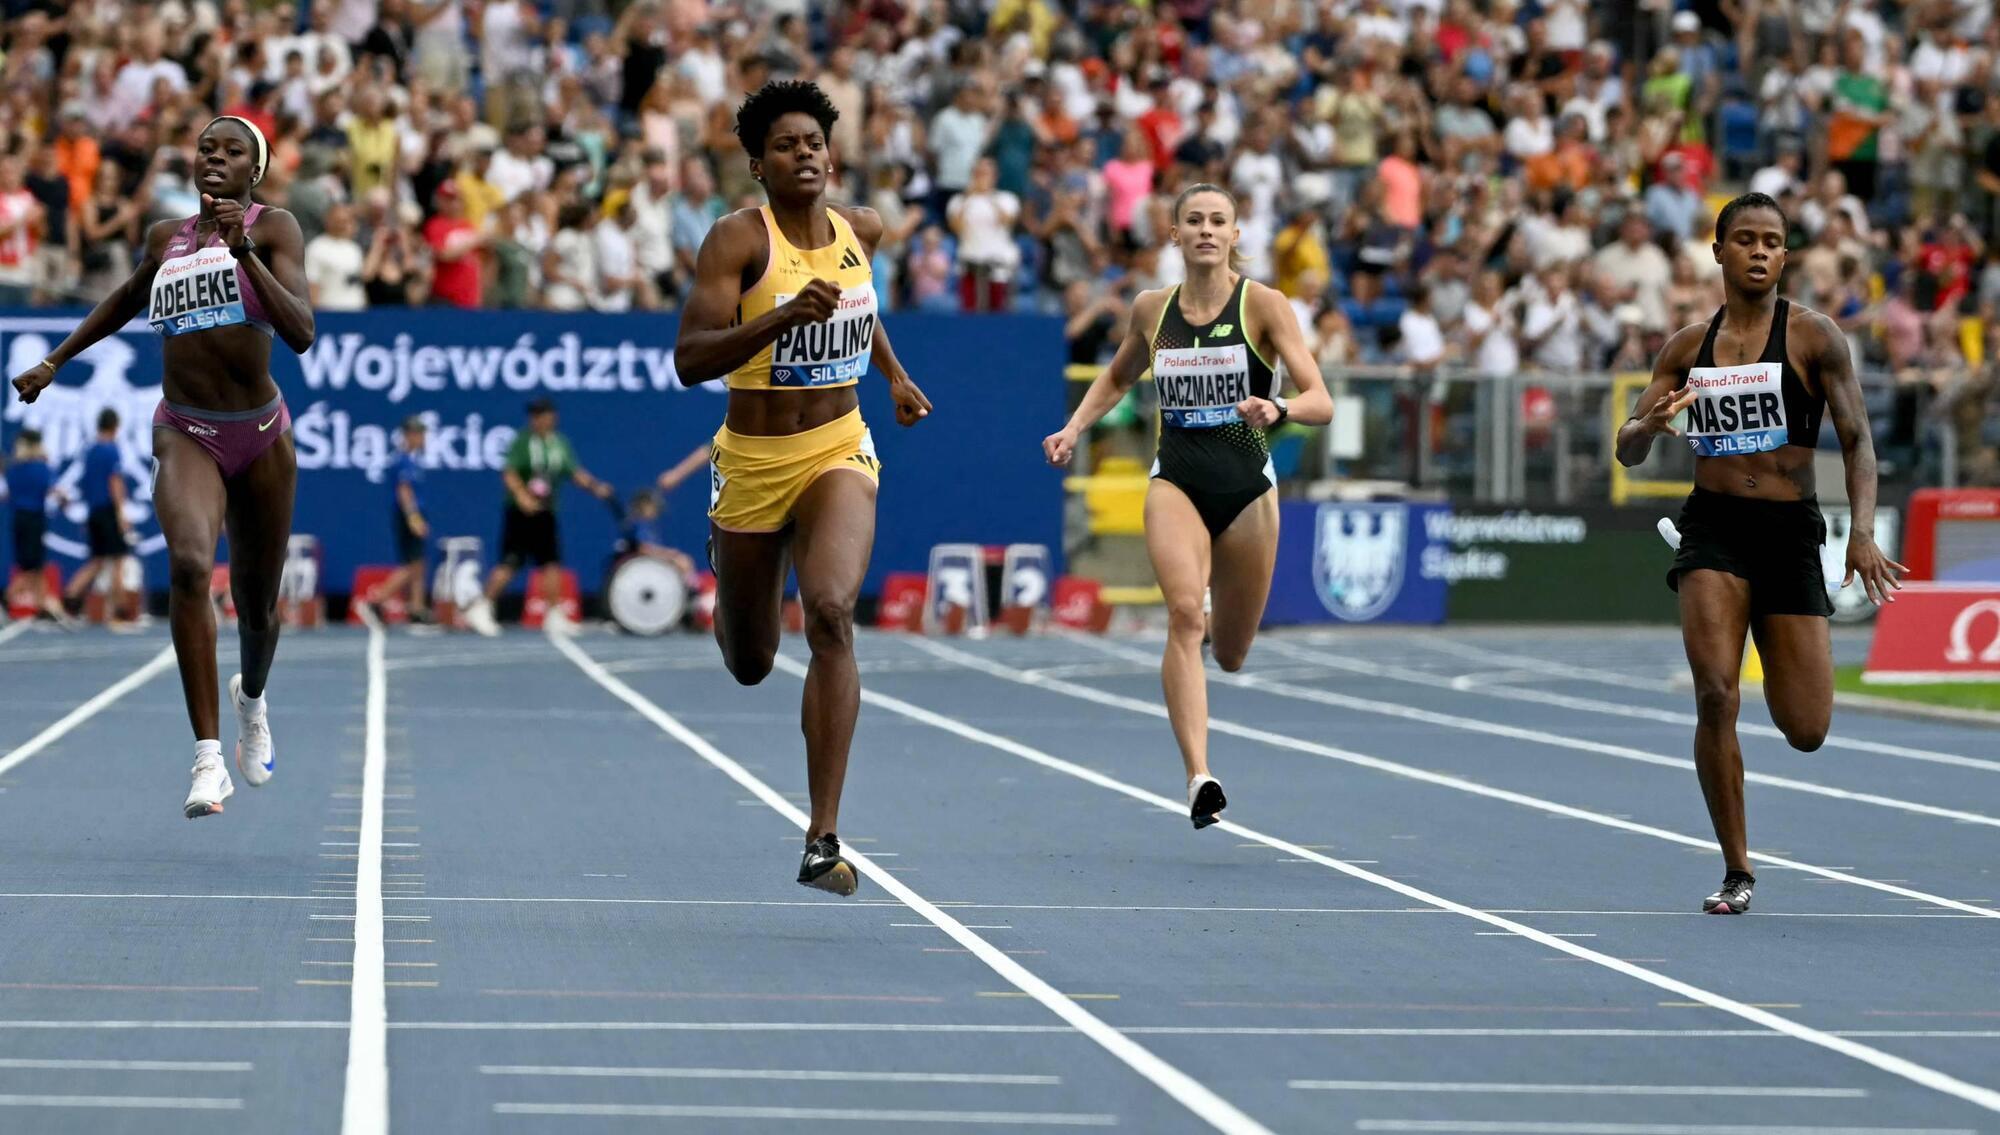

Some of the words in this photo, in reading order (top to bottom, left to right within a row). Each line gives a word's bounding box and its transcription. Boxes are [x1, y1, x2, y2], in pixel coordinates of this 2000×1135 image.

[152, 268, 239, 320] ADELEKE
[177, 309, 231, 331] SILESIA
[775, 313, 874, 363] PAULINO
[300, 332, 728, 402] Województw
[811, 363, 862, 382] SILESIA
[1164, 354, 1236, 367] Poland.Travel
[1156, 371, 1246, 407] KACZMAREK
[1184, 410, 1238, 425] SILESIA
[1686, 392, 1784, 433] NASER
[1714, 434, 1774, 452] SILESIA
